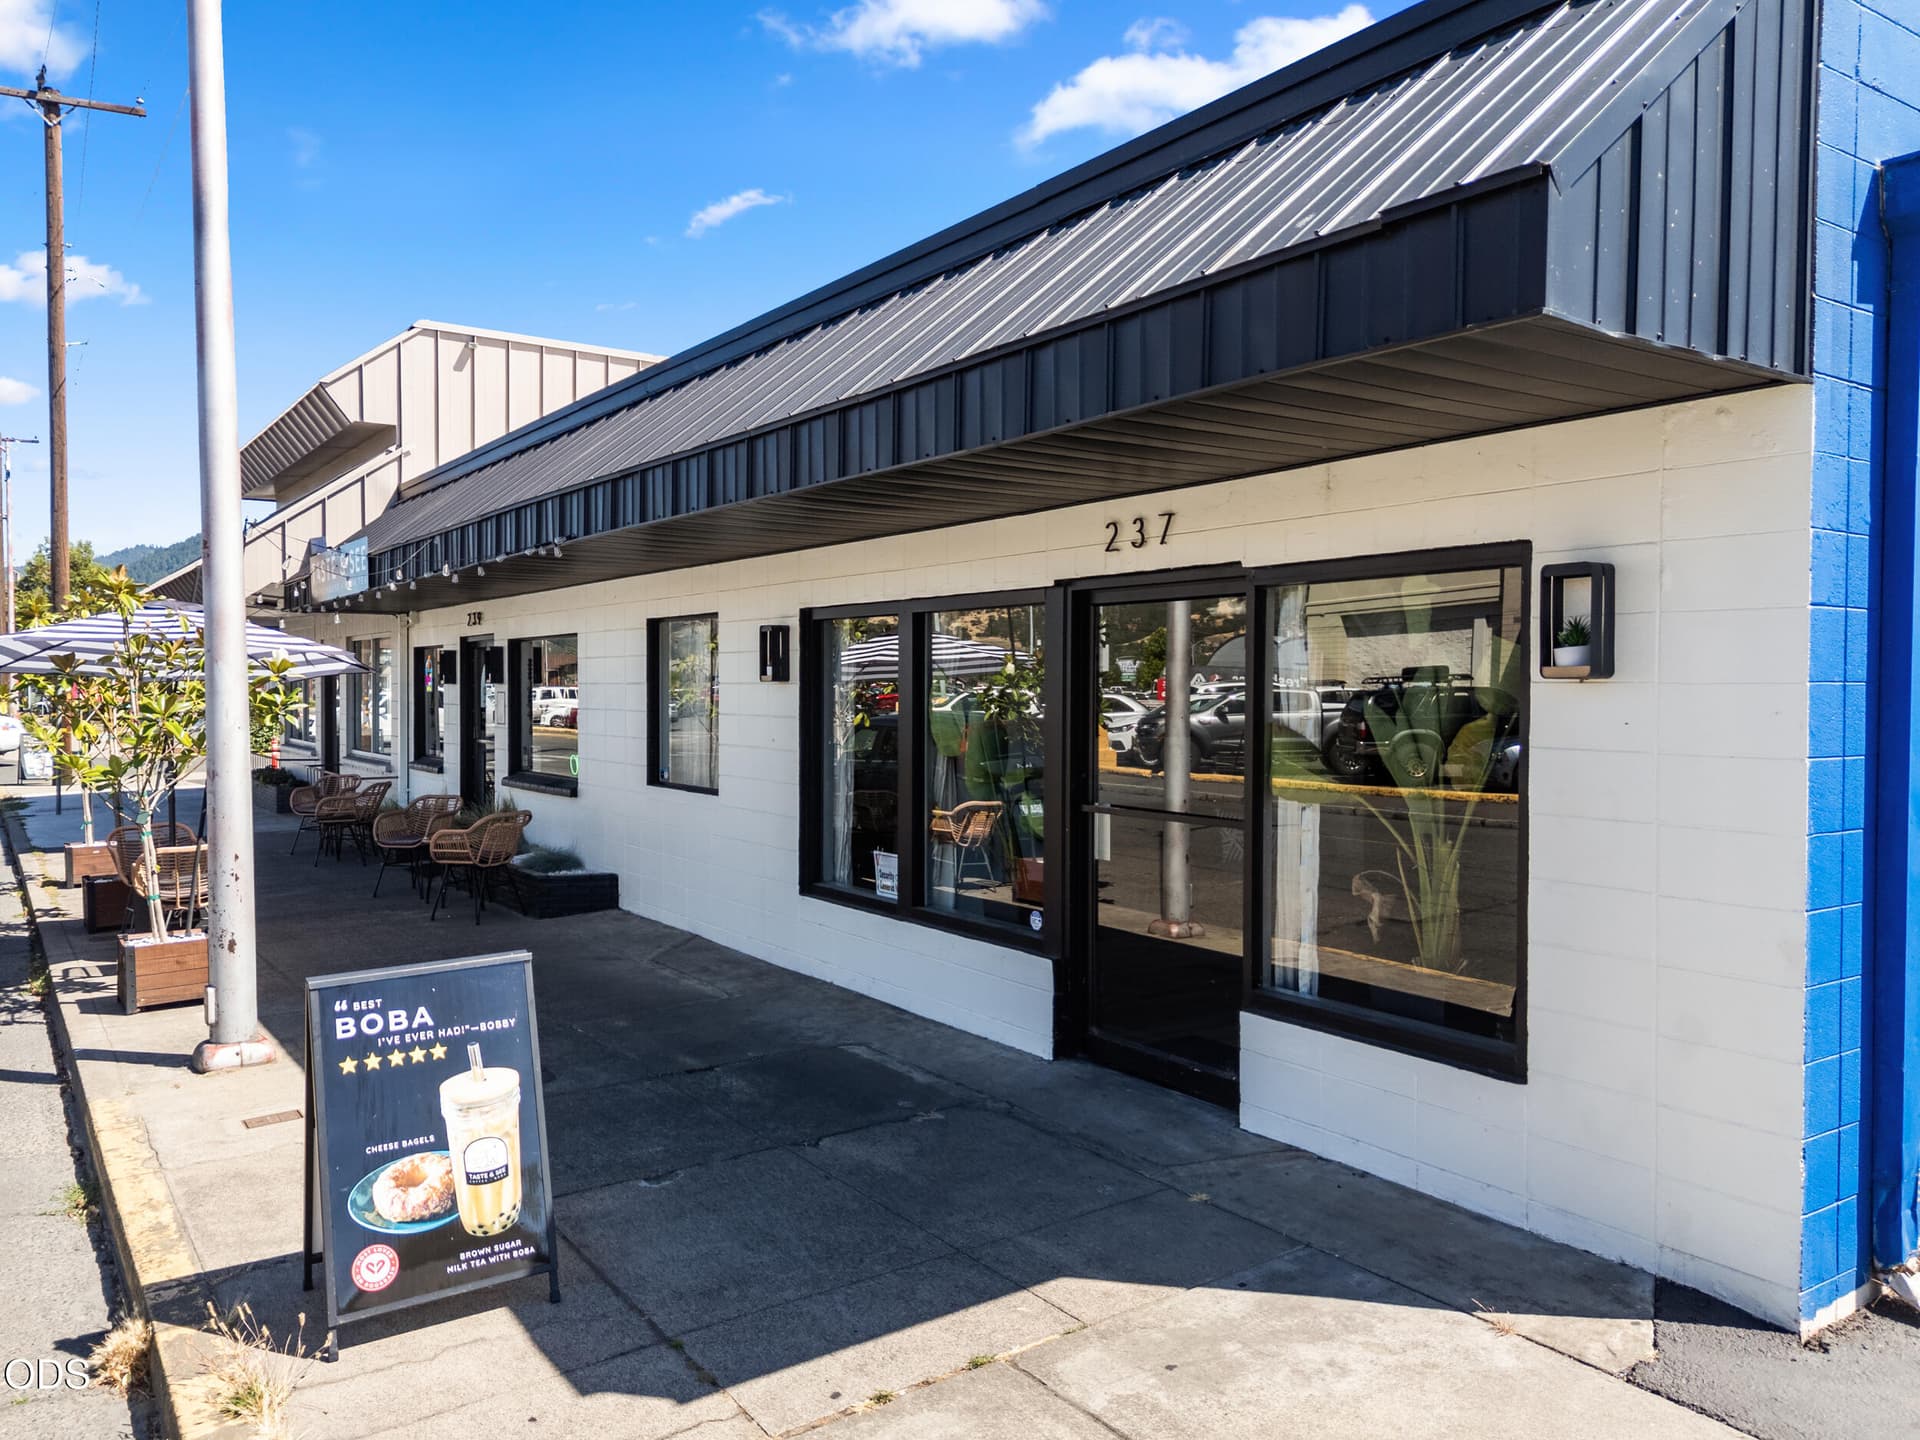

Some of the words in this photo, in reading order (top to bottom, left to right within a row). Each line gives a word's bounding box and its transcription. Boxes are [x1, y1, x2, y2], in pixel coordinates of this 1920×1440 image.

[1104, 512, 1176, 552] 237
[350, 545, 367, 575] SEE
[467, 611, 482, 626] 239
[335, 1006, 435, 1040] BOBA
[377, 1035, 401, 1047] I'VE
[405, 1030, 434, 1043] EVER
[365, 1141, 399, 1155] CHEESE
[401, 1134, 436, 1148] BAGELS
[446, 1262, 468, 1274] MILK
[470, 1258, 486, 1268] TEA
[489, 1252, 511, 1264] WITH
[512, 1246, 536, 1258] BOBA
[459, 1246, 491, 1260] BROWN
[494, 1239, 522, 1252] SUGAR
